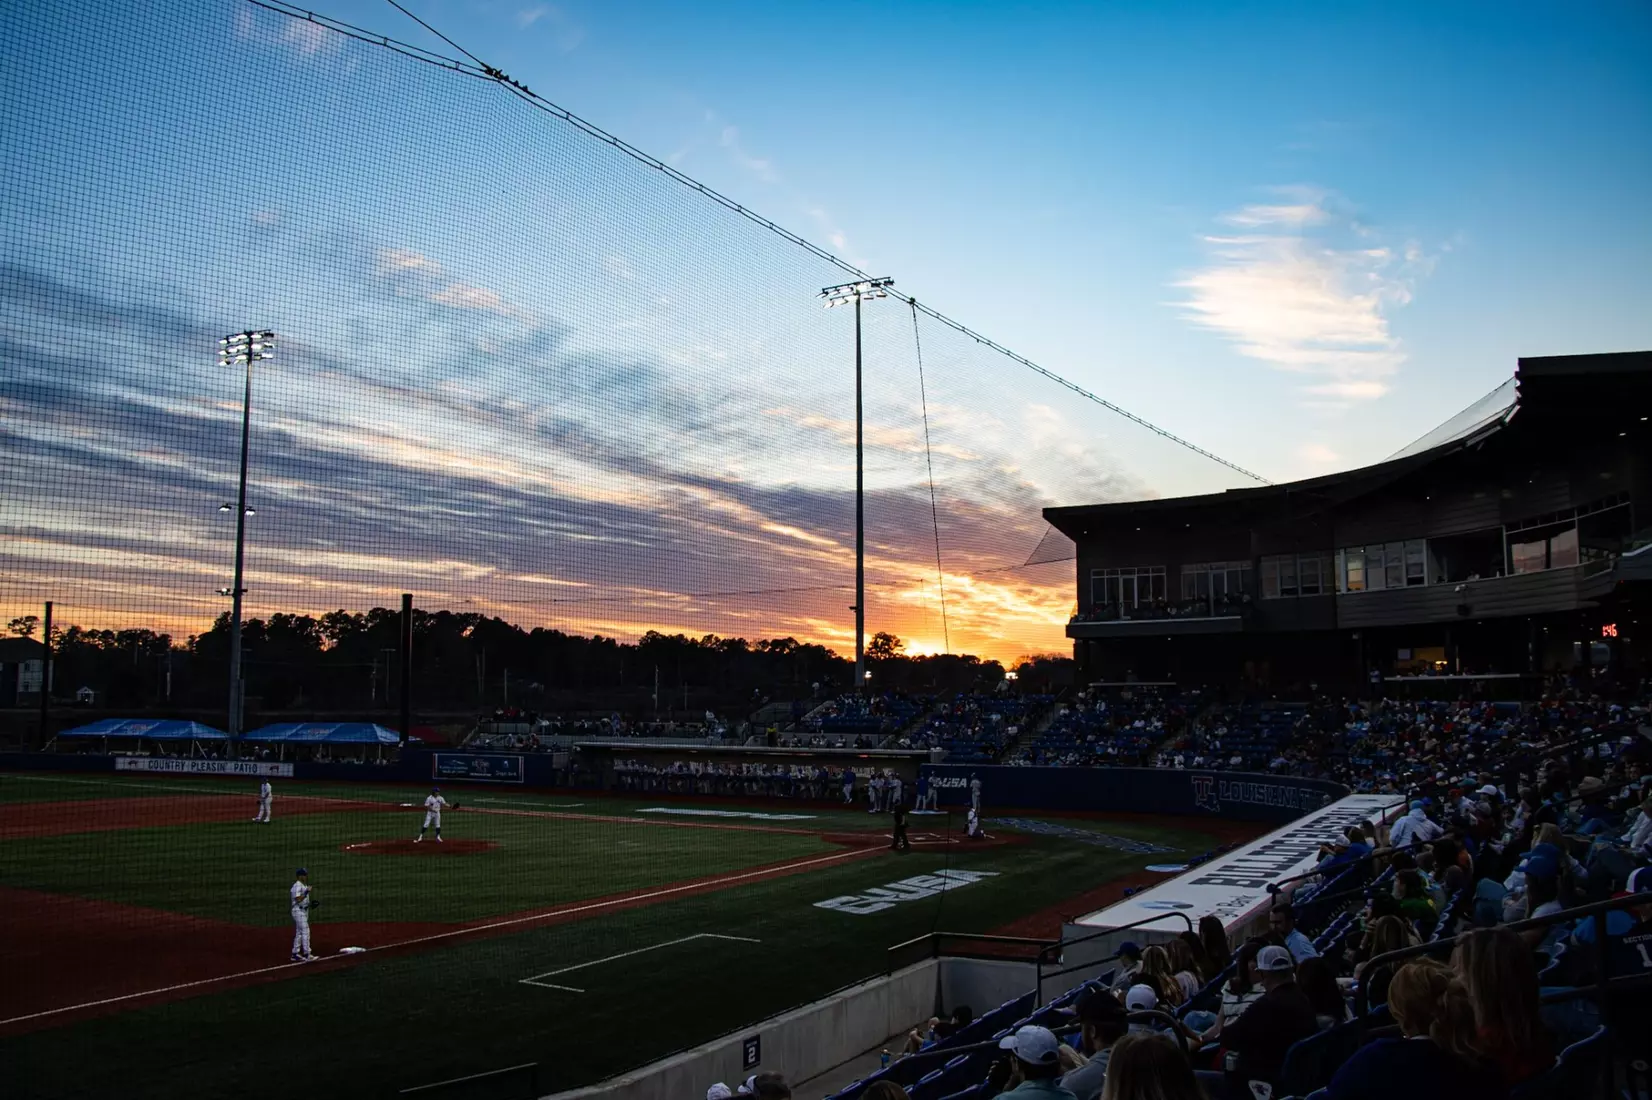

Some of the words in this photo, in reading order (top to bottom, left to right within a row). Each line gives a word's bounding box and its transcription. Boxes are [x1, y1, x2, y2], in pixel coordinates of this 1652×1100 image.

[148, 759, 186, 771] COUNTRY
[191, 760, 228, 772] PLEASIN'
[233, 762, 258, 774] PATIO
[1218, 780, 1299, 809] LOUISIANA
[1187, 840, 1327, 890] BULLDOG
[812, 868, 1001, 915] CUSA
[748, 1046, 756, 1064] 2
